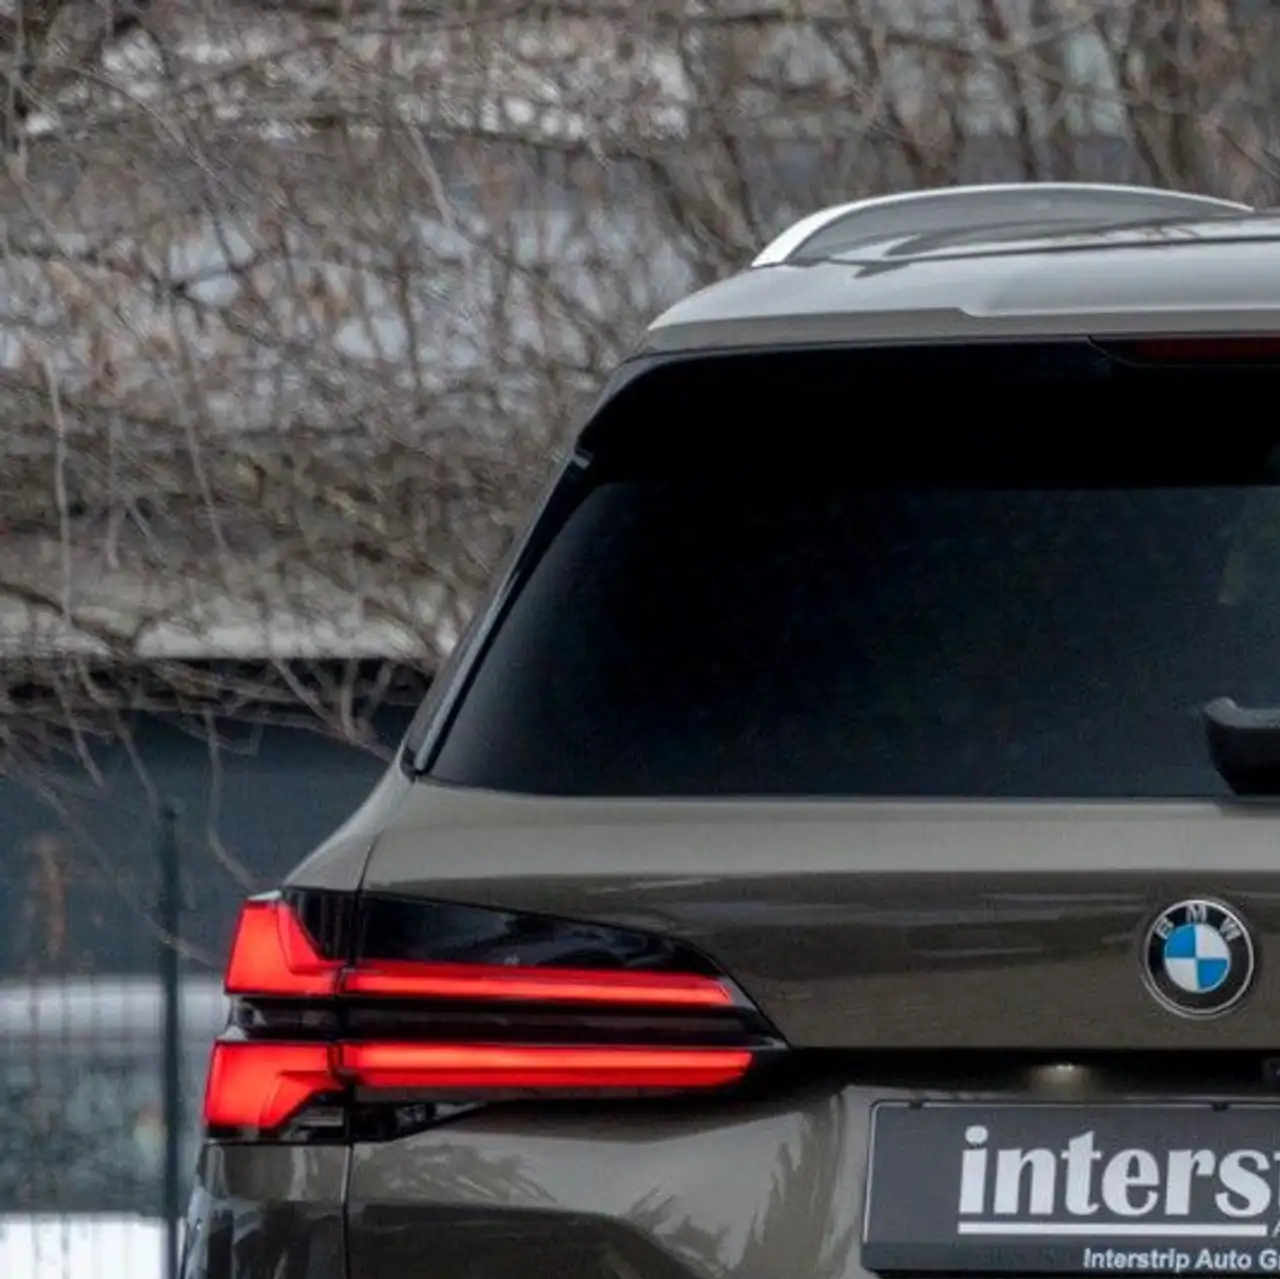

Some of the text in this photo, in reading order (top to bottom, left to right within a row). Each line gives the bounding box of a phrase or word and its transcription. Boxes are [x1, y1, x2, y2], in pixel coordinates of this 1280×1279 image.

[1153, 903, 1241, 941] BMW
[1083, 1248, 1190, 1273] Interstrip
[1194, 1249, 1252, 1269] Auto
